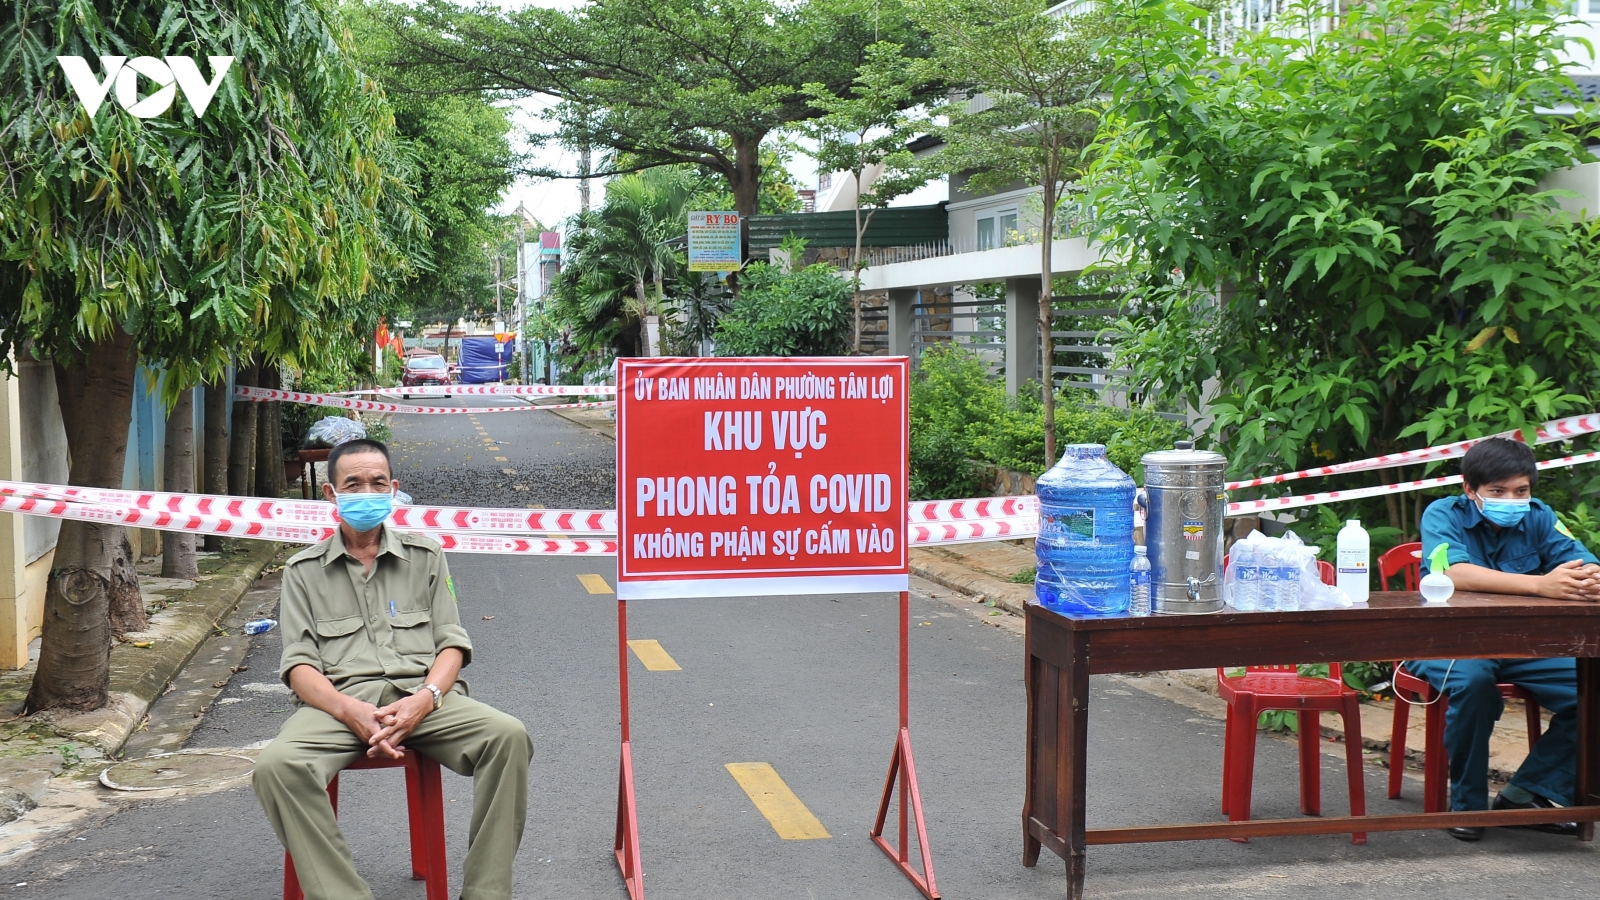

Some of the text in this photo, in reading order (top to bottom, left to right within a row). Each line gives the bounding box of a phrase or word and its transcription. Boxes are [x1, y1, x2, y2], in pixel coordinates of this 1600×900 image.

[706, 214, 721, 224] RY
[723, 214, 738, 224] BO
[635, 370, 893, 403] ỦY BAN NHÂN DÂN PHƯỜNG TÂN LỢI
[705, 407, 826, 458] KHU VỰC
[637, 462, 891, 516] PHONG TỎA COVID
[634, 521, 894, 561] KHÔNG PHẬN SỰ CẤM VÀO
